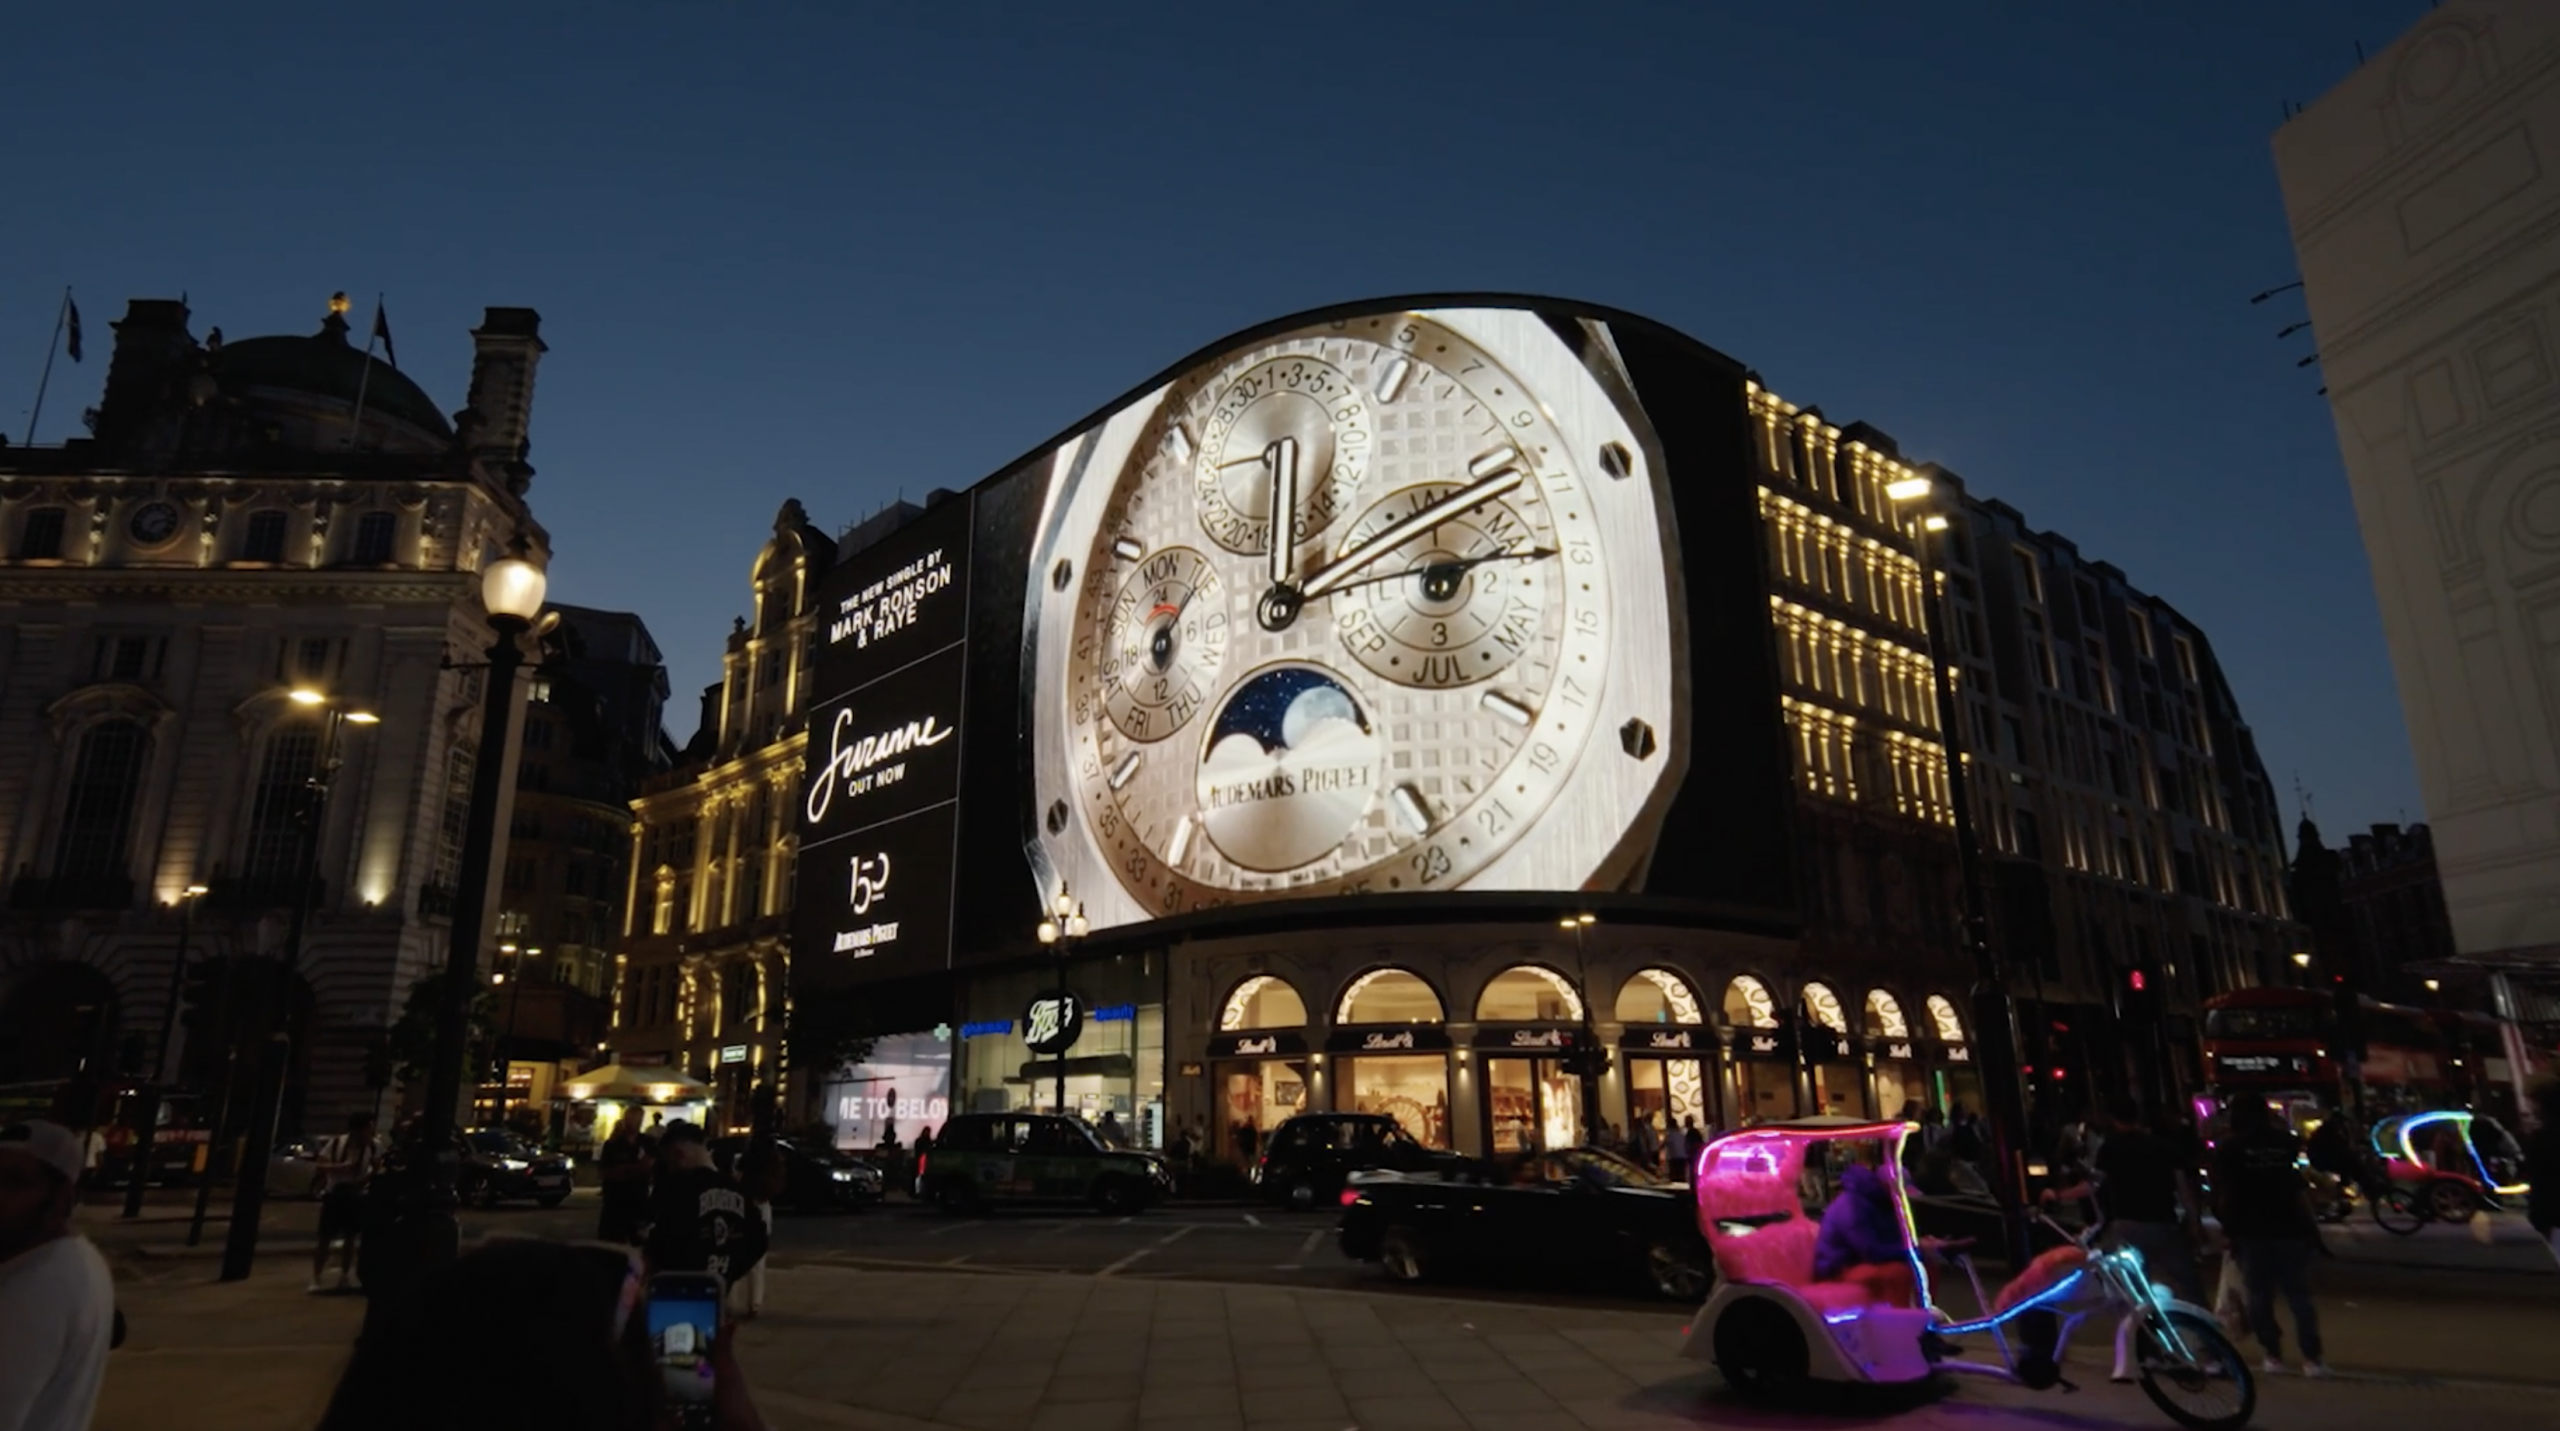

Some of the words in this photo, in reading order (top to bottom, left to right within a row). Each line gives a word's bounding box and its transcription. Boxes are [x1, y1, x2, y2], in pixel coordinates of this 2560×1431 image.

[1398, 323, 1420, 344] 5
[1266, 366, 1274, 389] 1
[1287, 363, 1304, 387] 3
[1460, 357, 1485, 375] 7
[1233, 377, 1257, 407] 30
[1310, 369, 1331, 393] 5
[1327, 385, 1352, 404] 7
[1216, 407, 1235, 437] 28
[1335, 404, 1361, 422] 8
[1511, 410, 1535, 428] 9
[1200, 442, 1221, 468] 26
[1340, 430, 1367, 454] 10
[1198, 474, 1217, 501] 24
[1331, 463, 1361, 488] 12
[1204, 500, 1228, 532] 22
[1310, 490, 1339, 520] 14
[1222, 518, 1247, 547] 20
[1569, 536, 1593, 565] 13
[841, 594, 859, 615] THE
[861, 581, 885, 603] NEW
[887, 558, 924, 590] SINGLE
[927, 548, 942, 568] BY
[1143, 553, 1180, 589] MON
[1188, 557, 1218, 602] TUE
[1483, 571, 1497, 594] 2
[830, 605, 874, 644] MARK
[880, 563, 951, 618] RONSON
[1153, 587, 1168, 606] 24
[857, 628, 867, 649] &
[874, 602, 917, 640] RAYE
[1111, 589, 1138, 638] SUN
[1493, 596, 1539, 654] MAY
[1575, 608, 1599, 637] 15
[1186, 621, 1197, 642] 6
[1201, 612, 1227, 668] WED
[1339, 608, 1386, 655] SEP
[1431, 622, 1448, 646] 3
[1124, 645, 1139, 666] 18
[1413, 655, 1472, 684] JUL
[1103, 659, 1124, 702] SAT
[1153, 678, 1168, 702] 12
[1561, 675, 1587, 708] 17
[1076, 694, 1090, 726] 39
[1165, 681, 1202, 728] THU
[1124, 706, 1152, 737] FRI
[807, 707, 954, 823] Suzanne
[1083, 753, 1100, 781] 37
[1529, 742, 1561, 775] 19
[849, 775, 873, 797] OUT
[876, 763, 906, 788] NOW
[1301, 765, 1371, 793] PIGUET
[1099, 805, 1119, 838] 35
[1477, 798, 1515, 837] 21
[1126, 847, 1147, 882] 33
[1412, 845, 1452, 885] 23
[866, 1097, 890, 1119] TO
